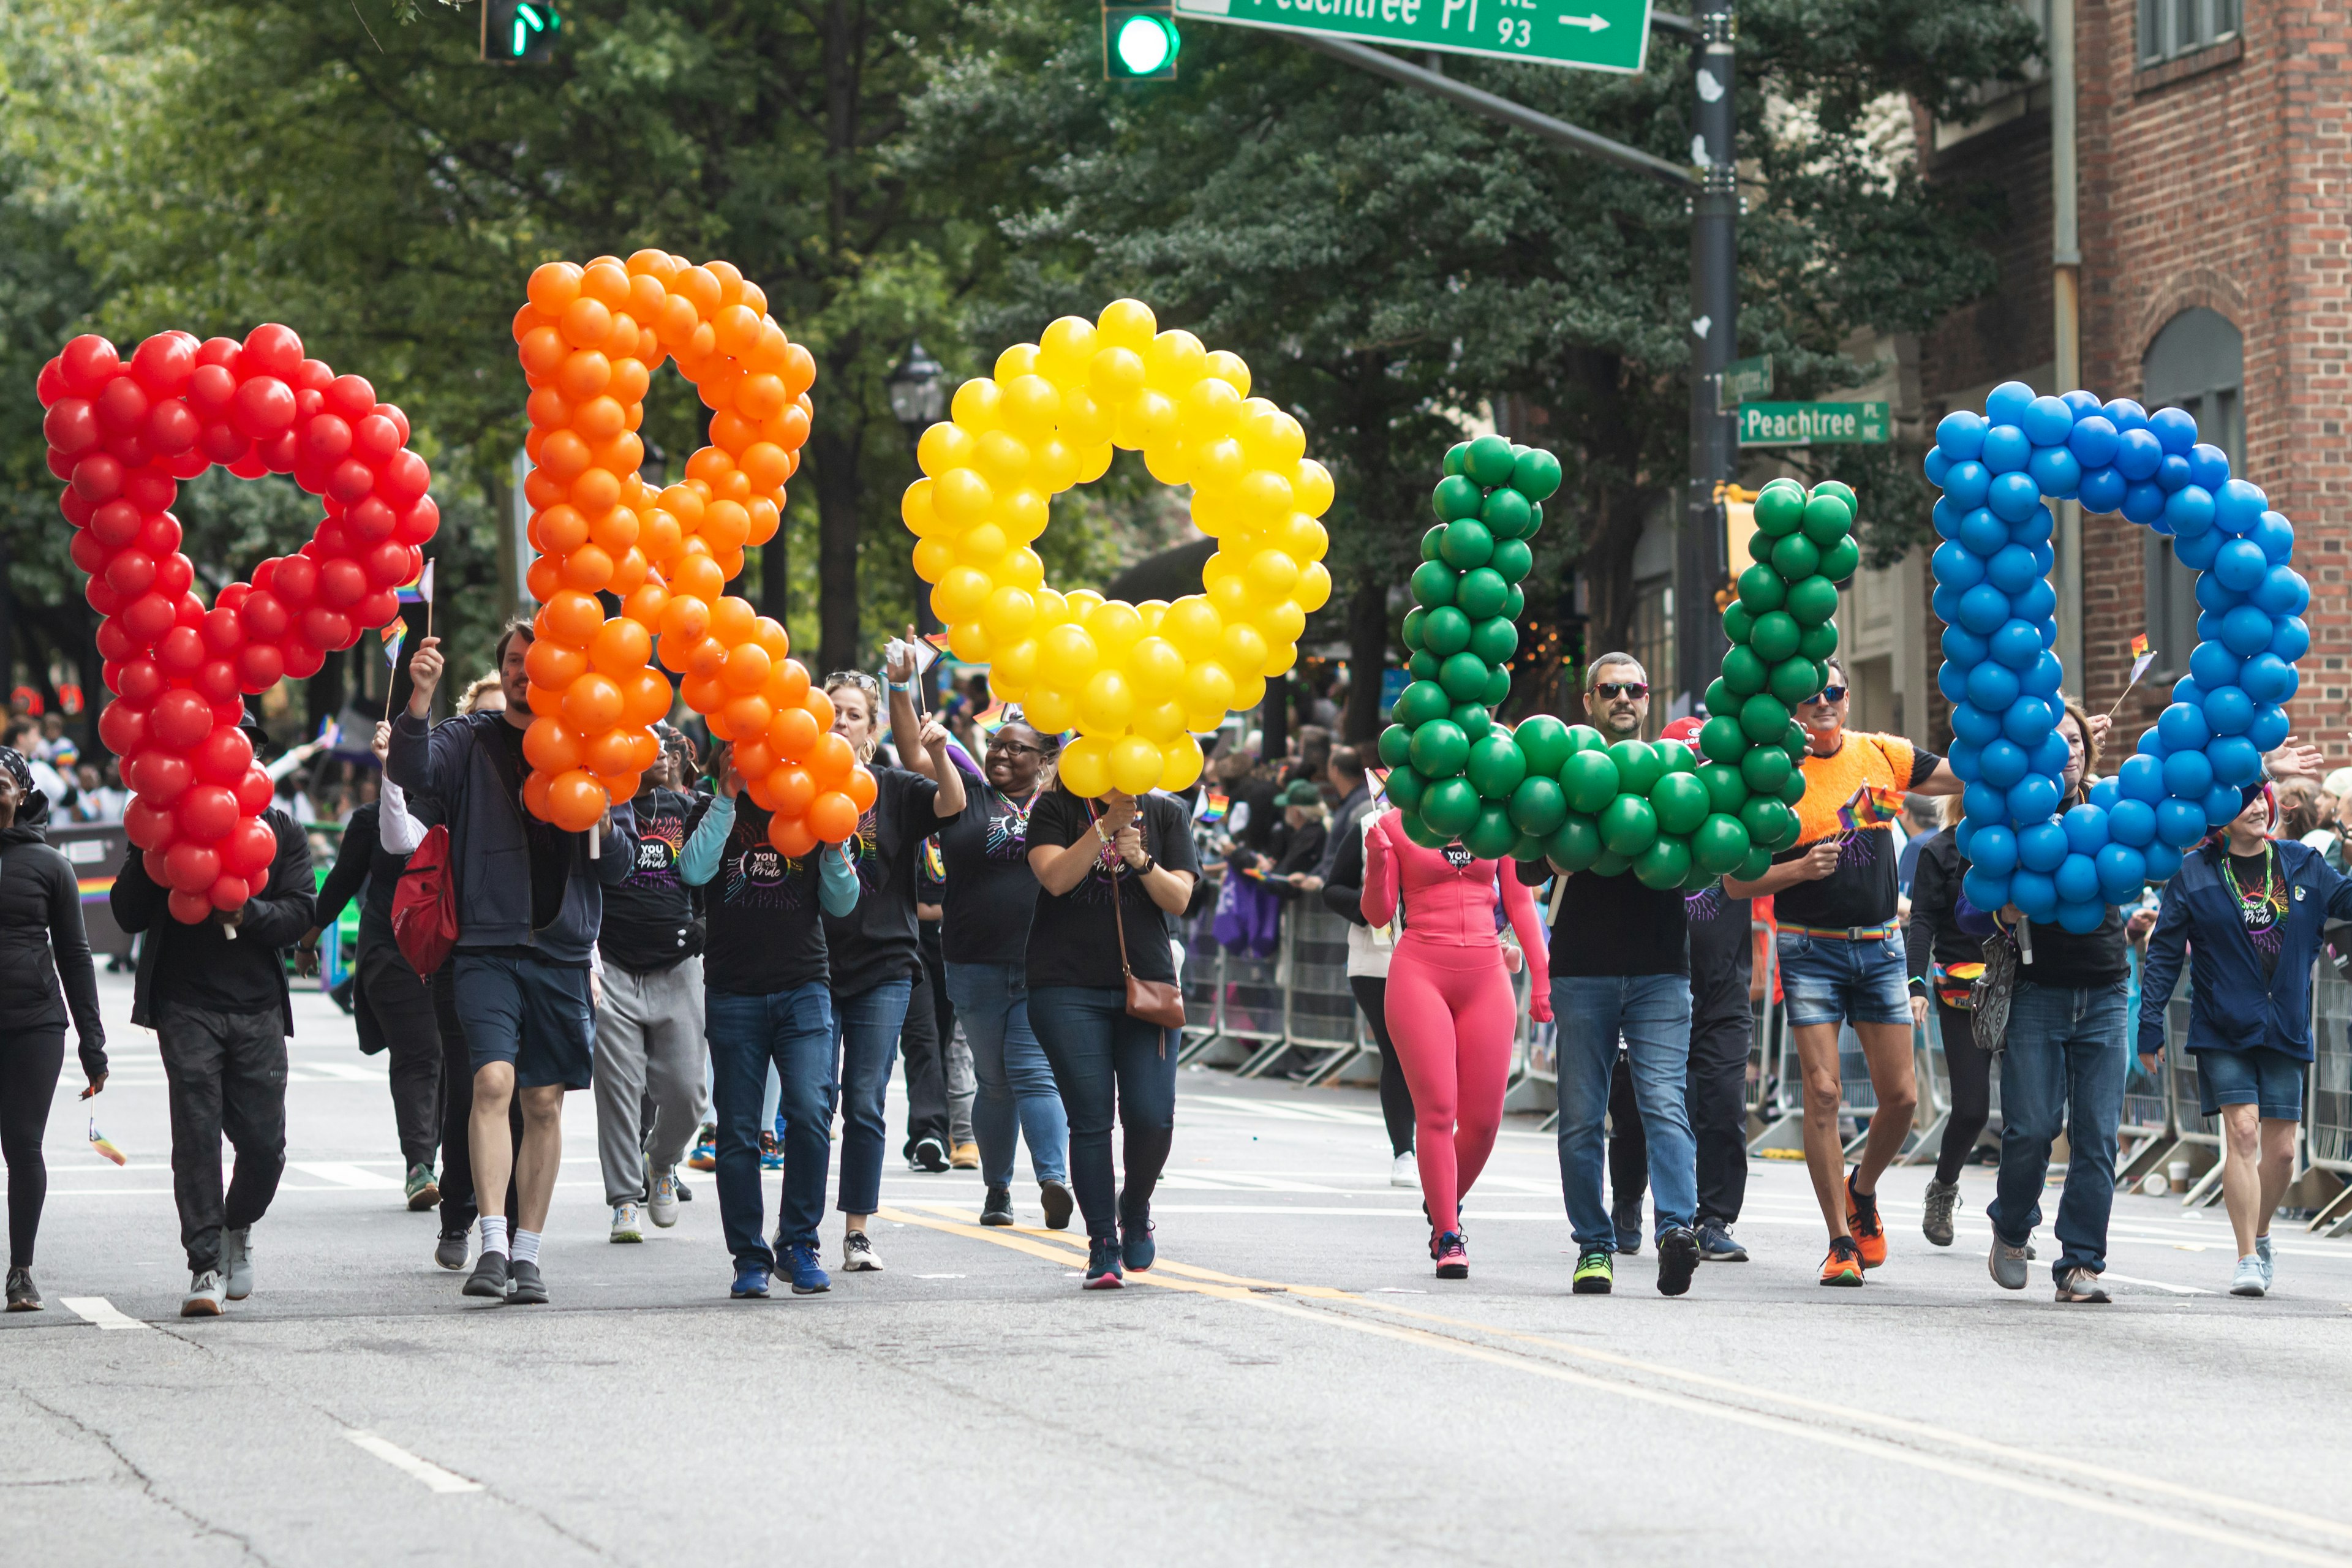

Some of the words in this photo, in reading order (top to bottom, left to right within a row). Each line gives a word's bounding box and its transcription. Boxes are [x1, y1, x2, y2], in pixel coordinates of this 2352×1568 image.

[1498, 17, 1531, 48] 93
[1863, 403, 1880, 418] PL
[1747, 409, 1855, 437] Peachtree
[1863, 424, 1881, 440] NE
[641, 845, 663, 854] YOU
[1447, 851, 1471, 860] YOU
[638, 857, 668, 869] Pride
[754, 853, 777, 862] YOU
[750, 865, 781, 878] Pride
[2244, 912, 2272, 924] Pride
